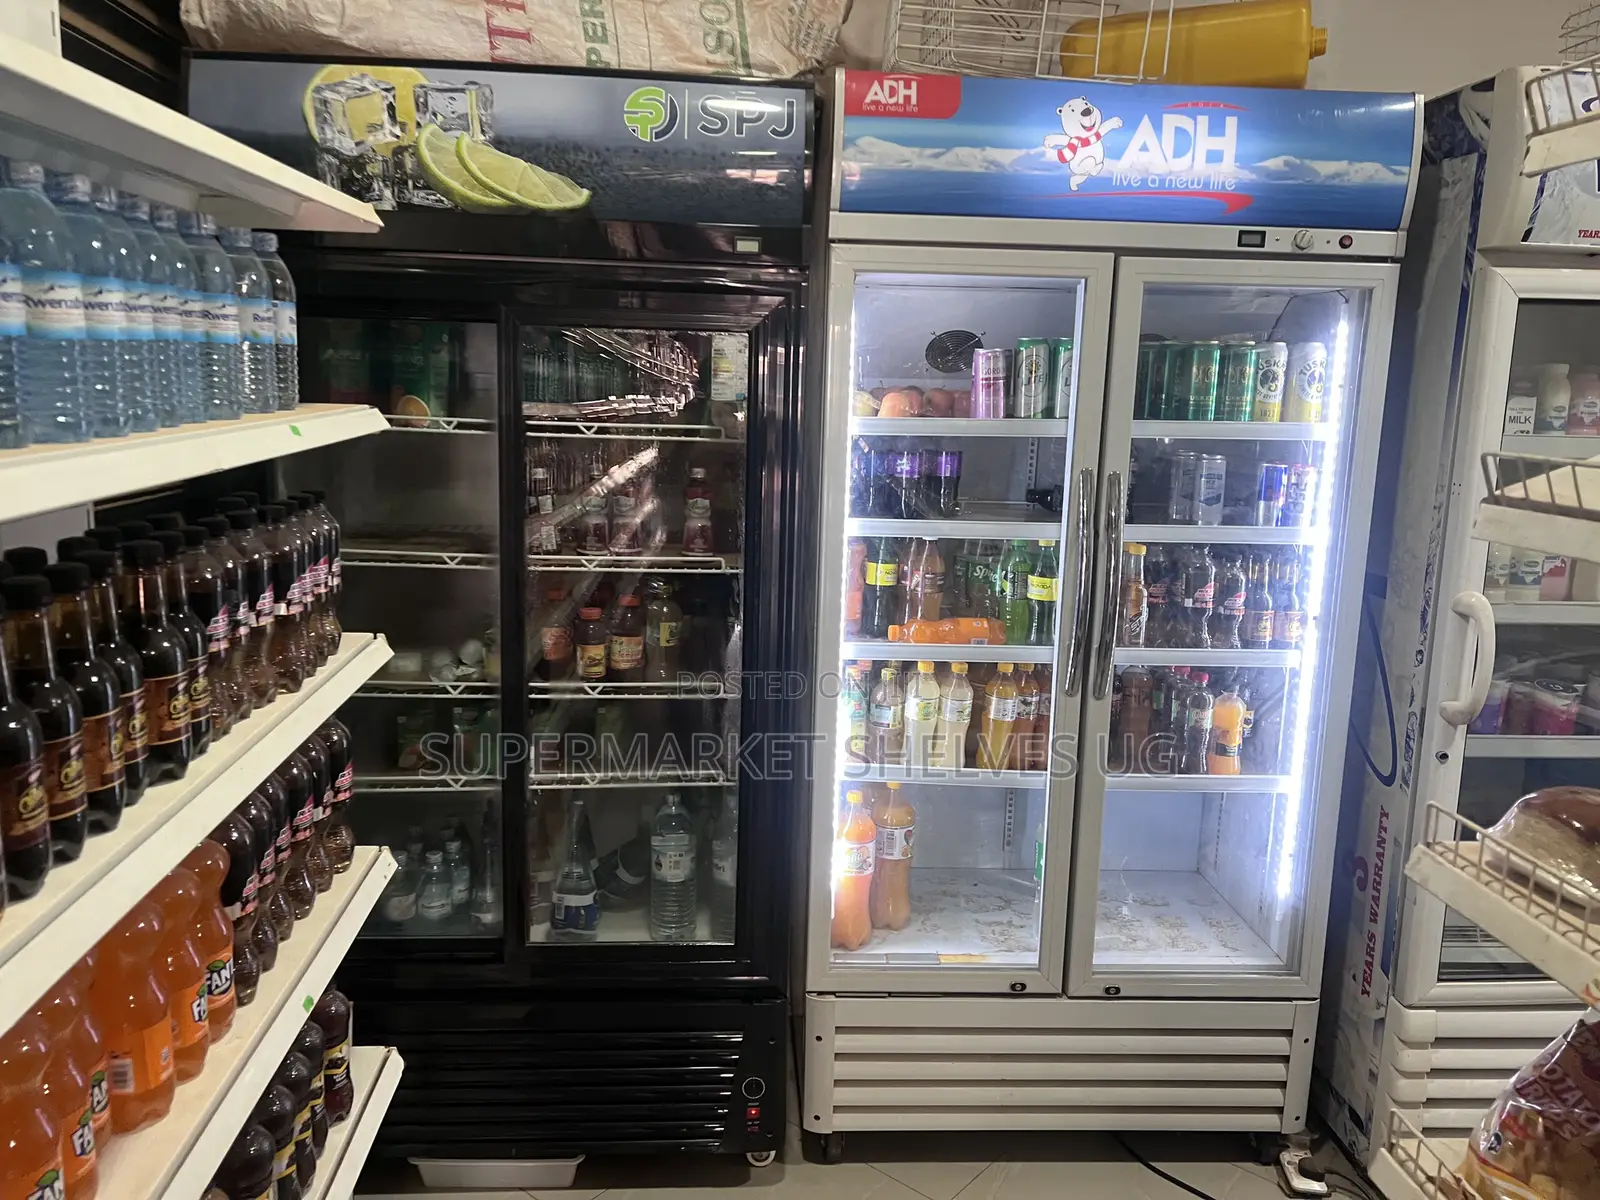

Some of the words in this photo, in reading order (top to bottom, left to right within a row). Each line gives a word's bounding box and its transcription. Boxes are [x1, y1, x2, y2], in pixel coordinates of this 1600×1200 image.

[864, 80, 917, 105] ADH
[697, 93, 797, 139] SPJ
[1117, 113, 1238, 172] ADH
[1112, 171, 1142, 187] live
[1147, 175, 1159, 188] a
[1165, 174, 1203, 189] new
[1209, 172, 1236, 190] life
[1578, 229, 1600, 238] YEAR
[1508, 415, 1532, 425] MILK
[1368, 804, 1390, 925] WARRANTY
[1360, 929, 1377, 998] YEARS
